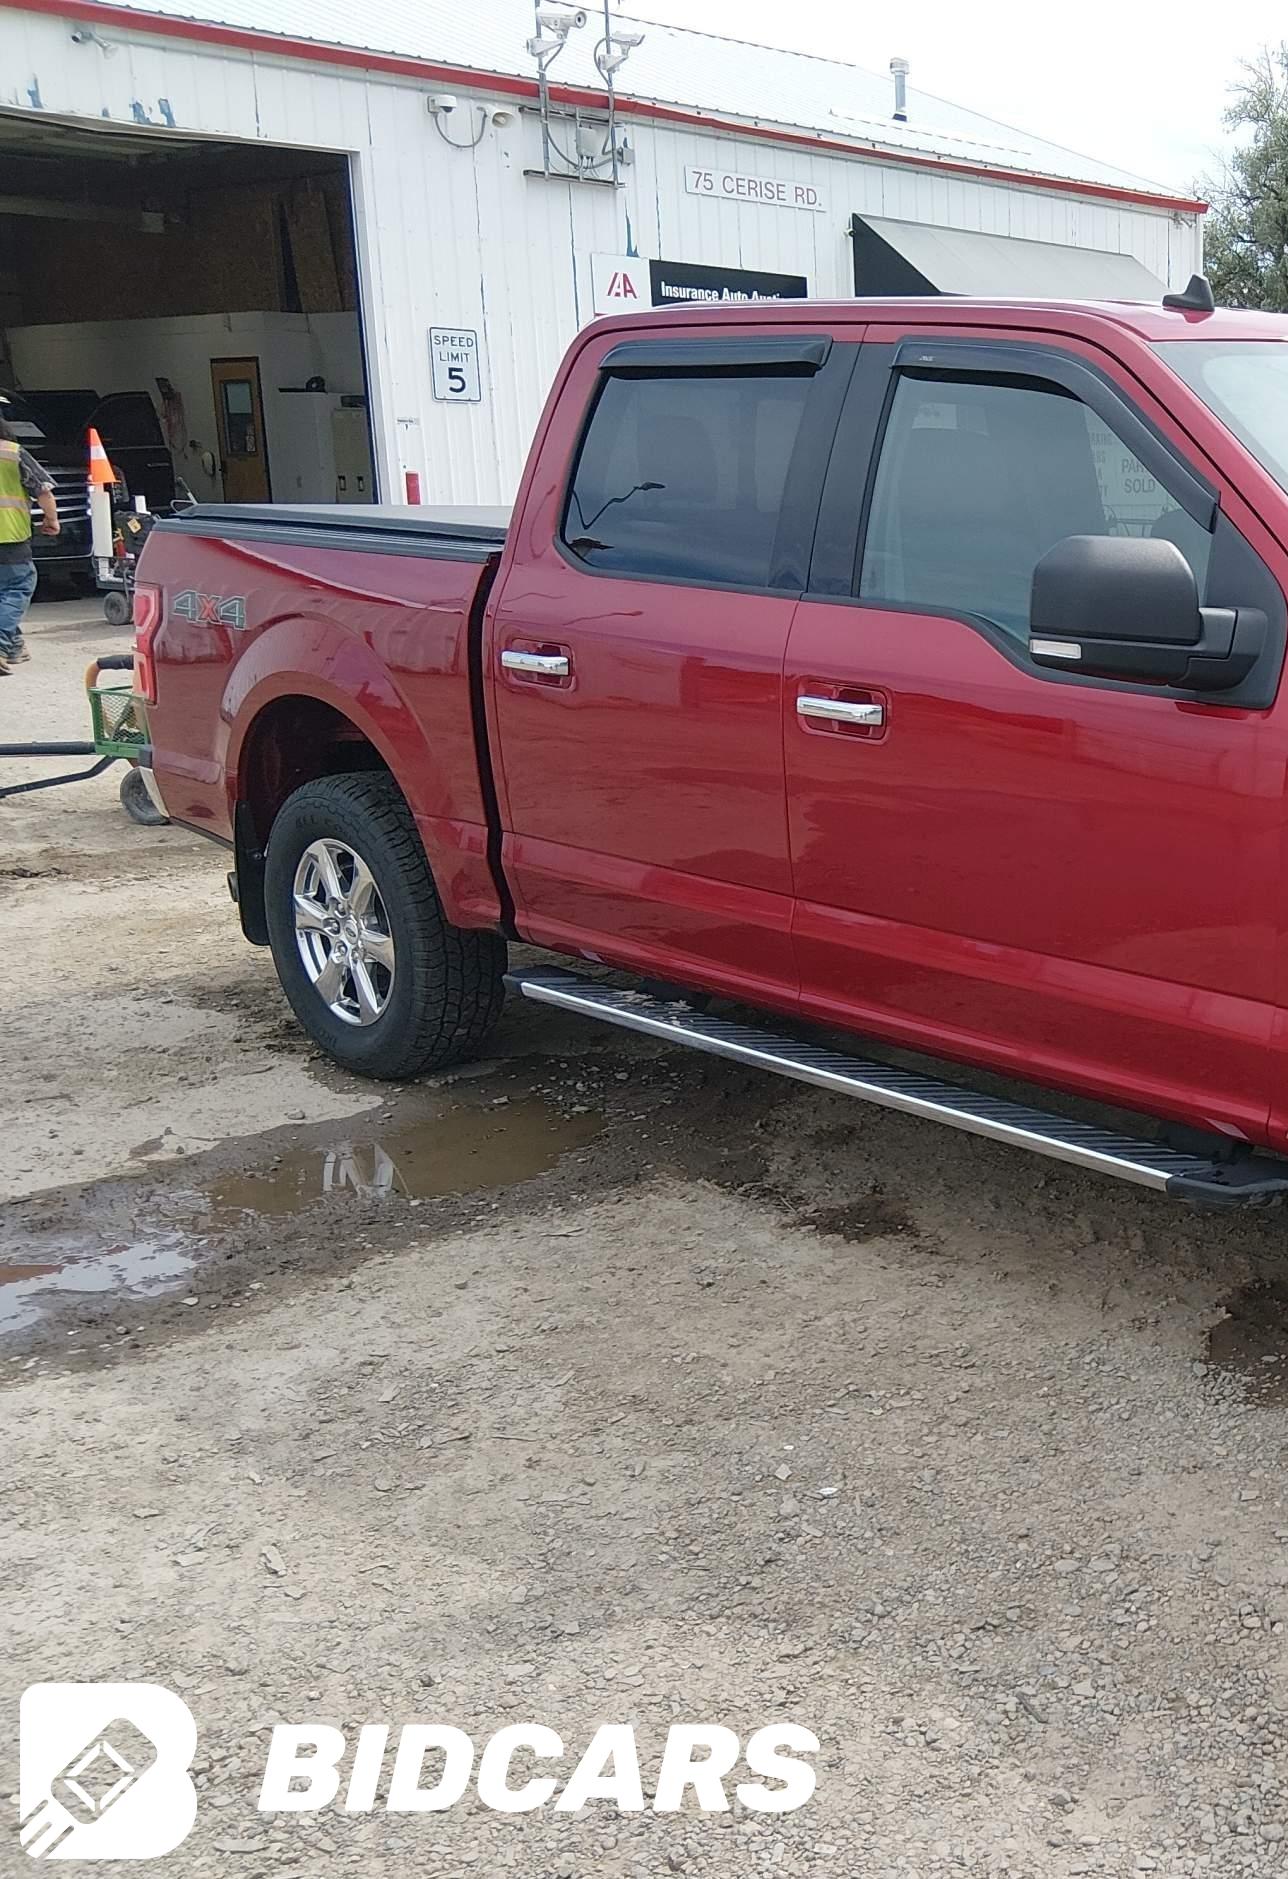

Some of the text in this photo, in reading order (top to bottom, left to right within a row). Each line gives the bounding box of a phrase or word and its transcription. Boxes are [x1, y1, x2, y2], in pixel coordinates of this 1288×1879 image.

[692, 170, 822, 207] 75 CERISE RD.
[660, 280, 719, 301] Insurance
[721, 287, 749, 301] Auto
[434, 335, 474, 348] SPEED
[439, 351, 470, 362] LIMIT
[447, 367, 466, 393] 5
[1124, 478, 1156, 494] SOLD
